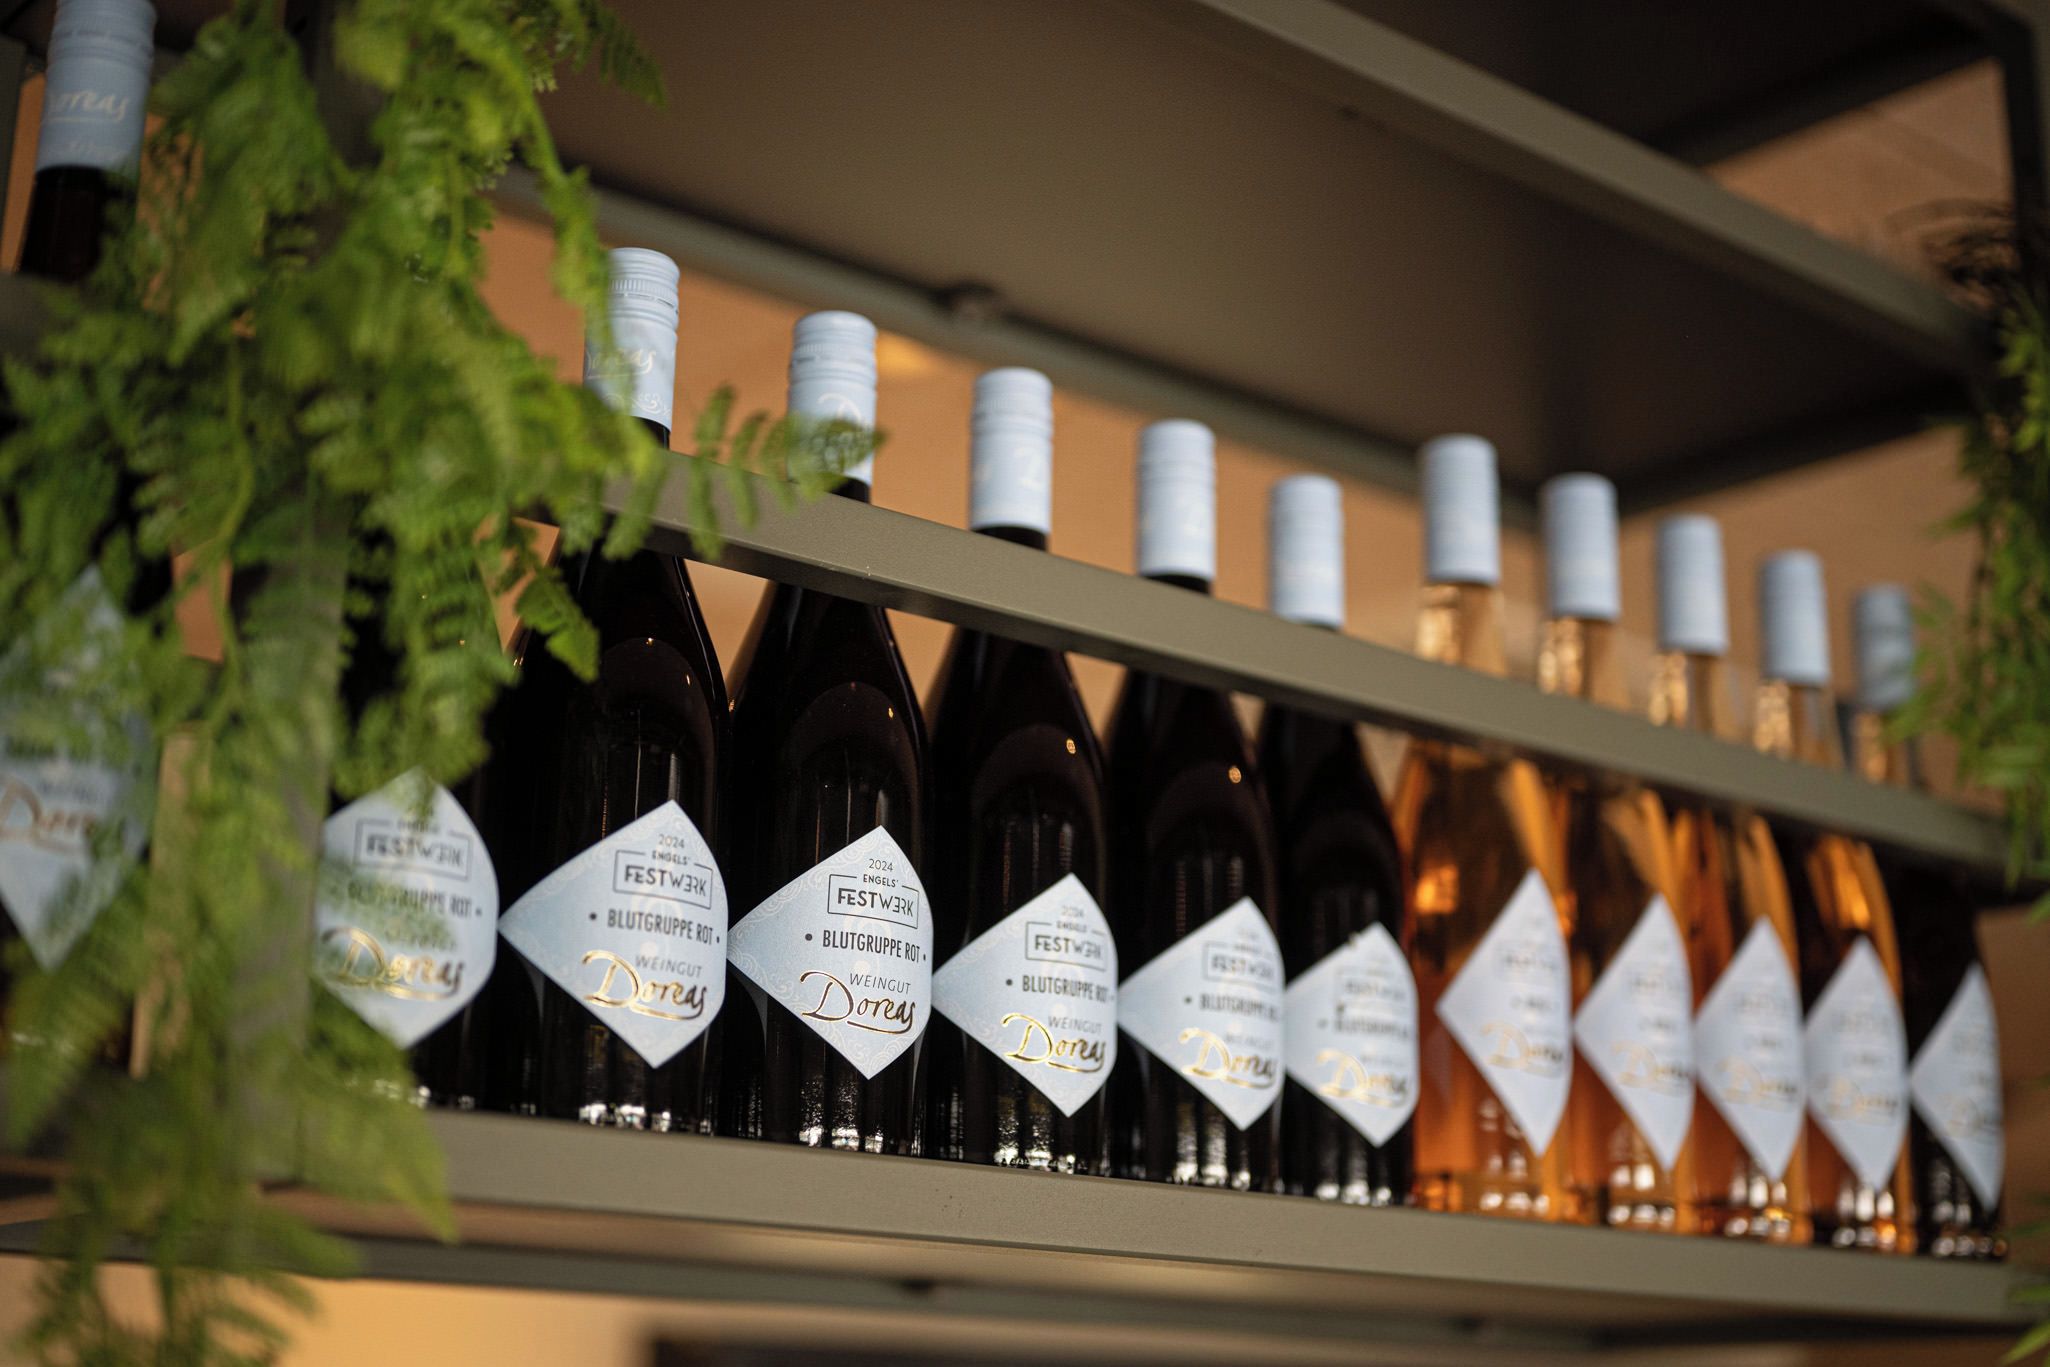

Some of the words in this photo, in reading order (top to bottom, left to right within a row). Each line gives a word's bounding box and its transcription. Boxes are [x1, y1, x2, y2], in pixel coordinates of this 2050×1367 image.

[658, 833, 685, 849] 2024
[868, 858, 894, 872] 2024
[607, 908, 694, 940] BLUTGRUPPE
[695, 924, 714, 946] ROT
[822, 929, 902, 958] BLUTGRUPPE
[904, 941, 920, 963] ROT
[634, 954, 703, 979] WEINGUT
[580, 949, 708, 1021] Doreas
[849, 972, 911, 995] WEINGUT
[1022, 974, 1094, 1001] BLUTGRUPPE
[800, 970, 916, 1035] Doreas
[1047, 1015, 1103, 1036] WEINGUT
[1001, 1012, 1107, 1074] Doreas
